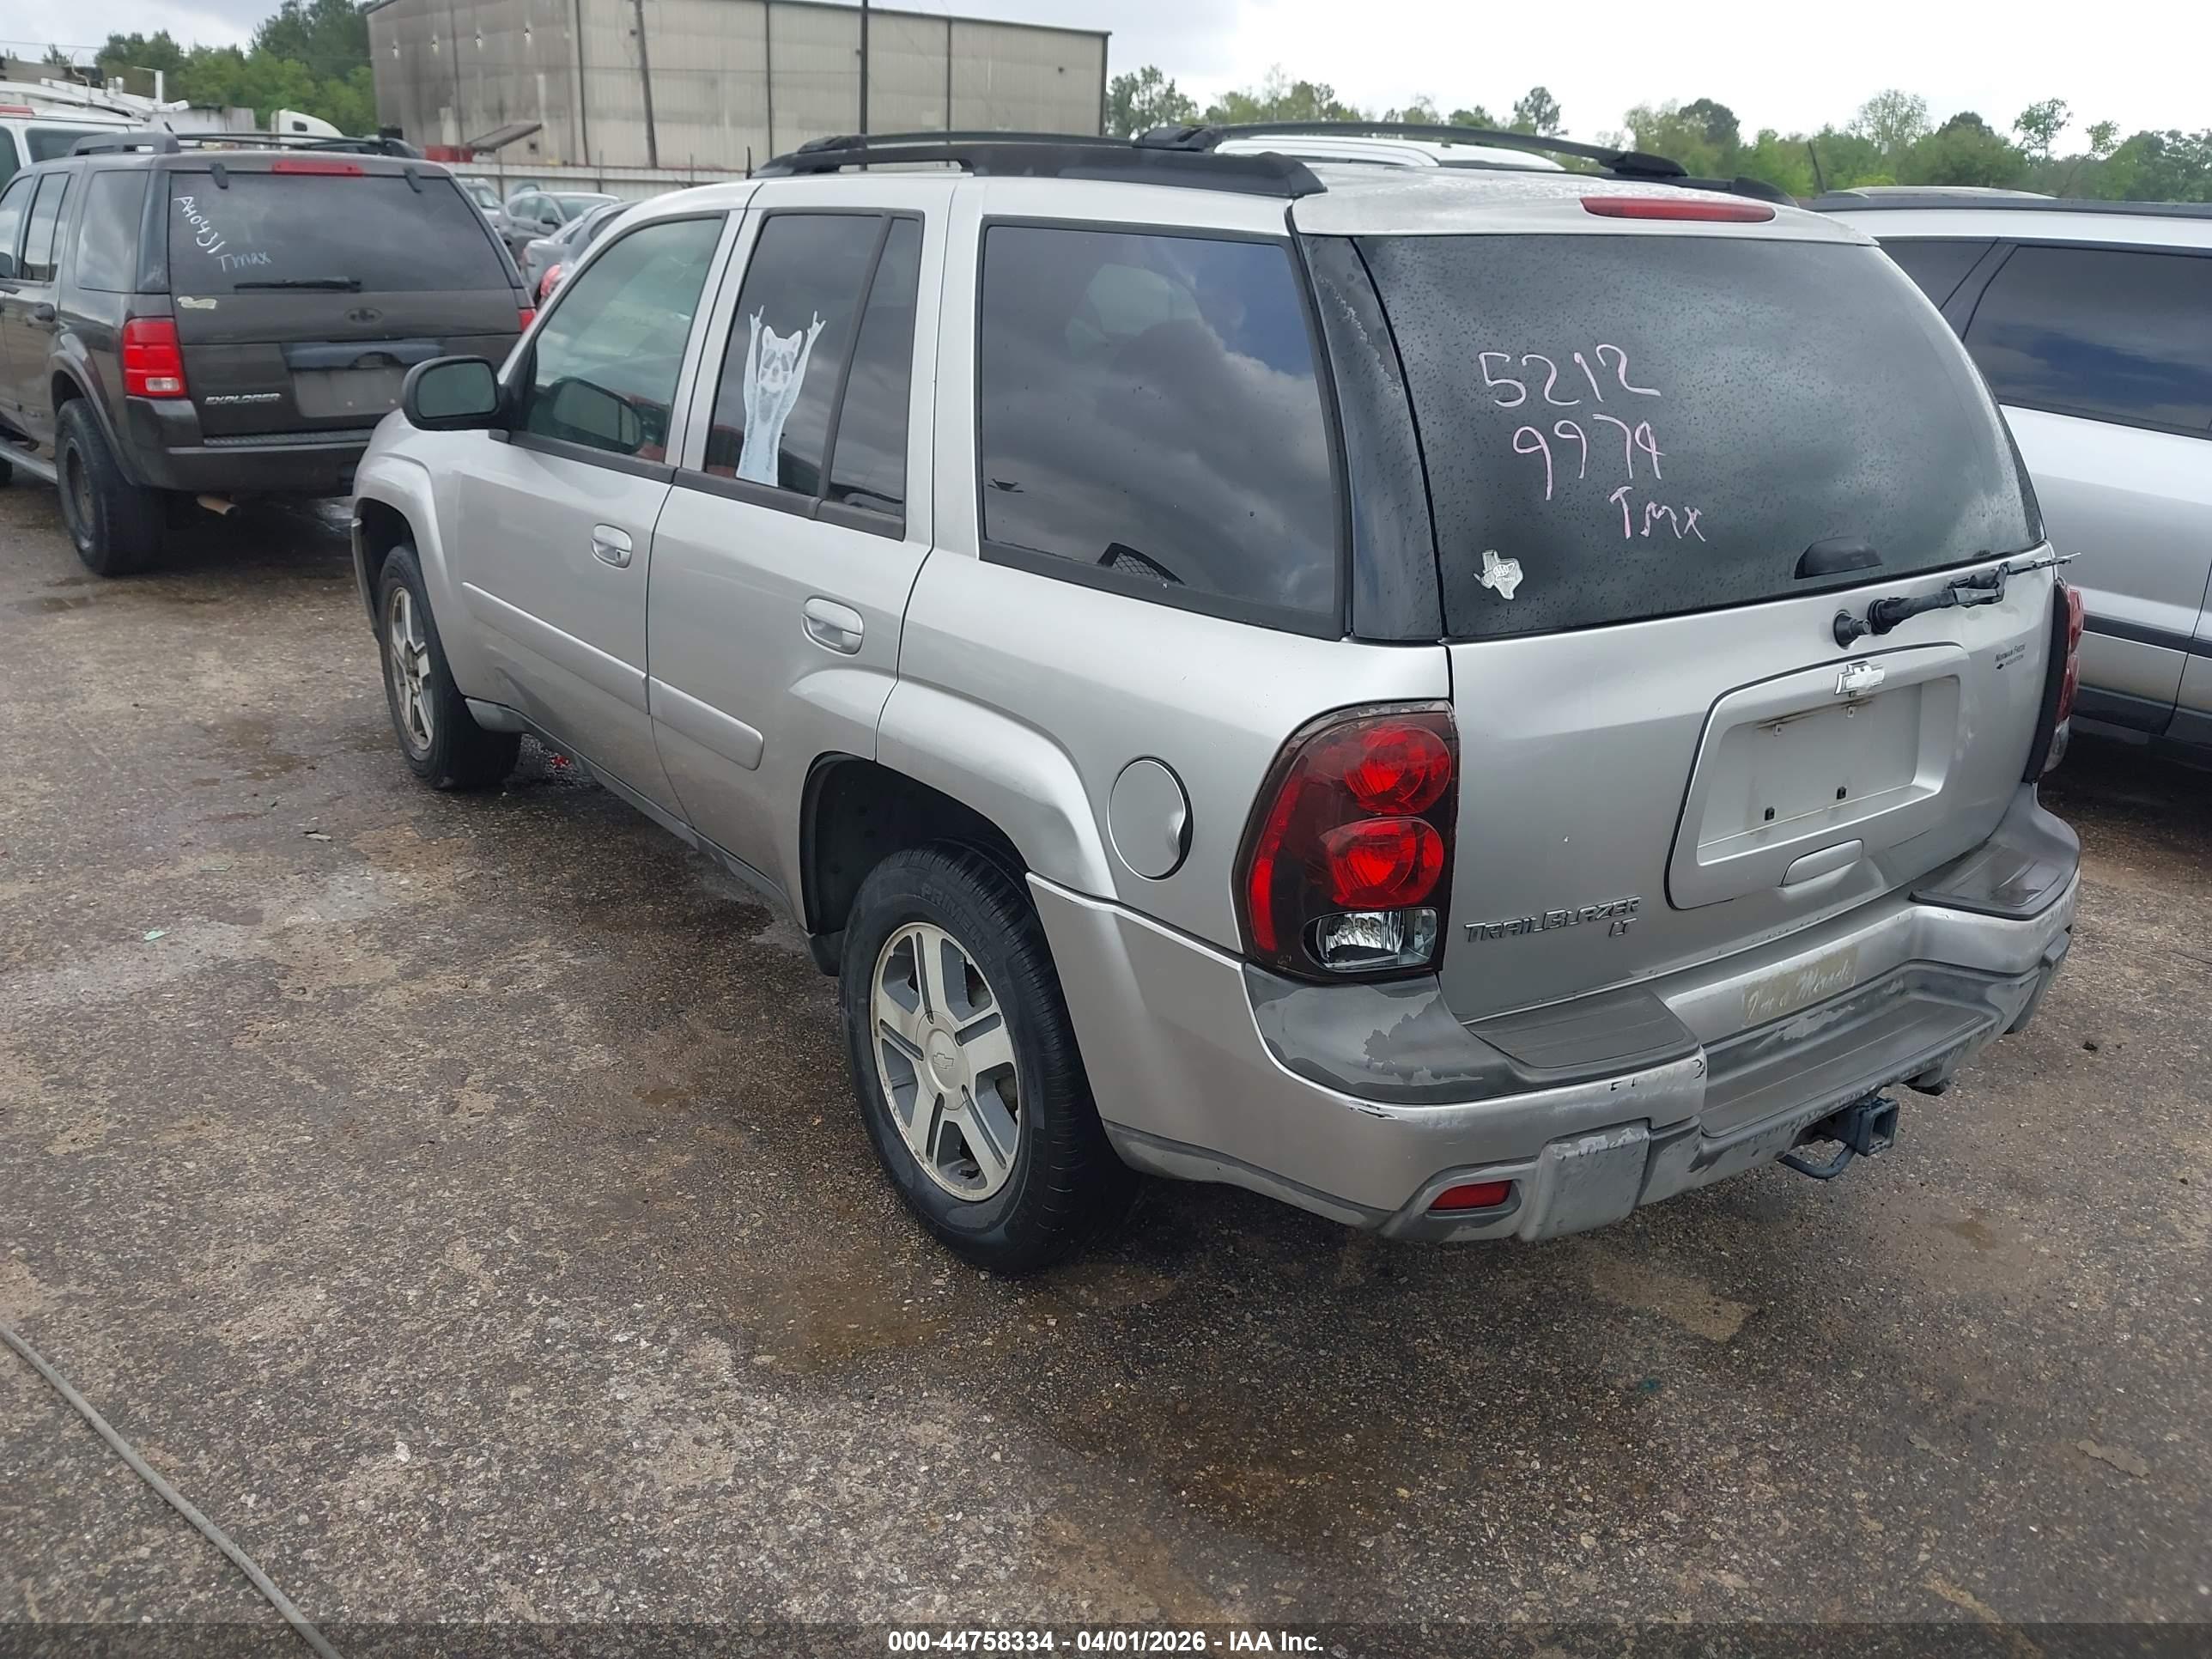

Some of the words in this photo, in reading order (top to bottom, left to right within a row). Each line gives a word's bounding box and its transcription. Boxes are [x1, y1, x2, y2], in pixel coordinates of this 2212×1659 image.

[1479, 343, 1662, 408] 5212
[205, 392, 282, 405] EXPLORER
[1512, 414, 1667, 501] 9974
[1608, 917, 1638, 938] LT
